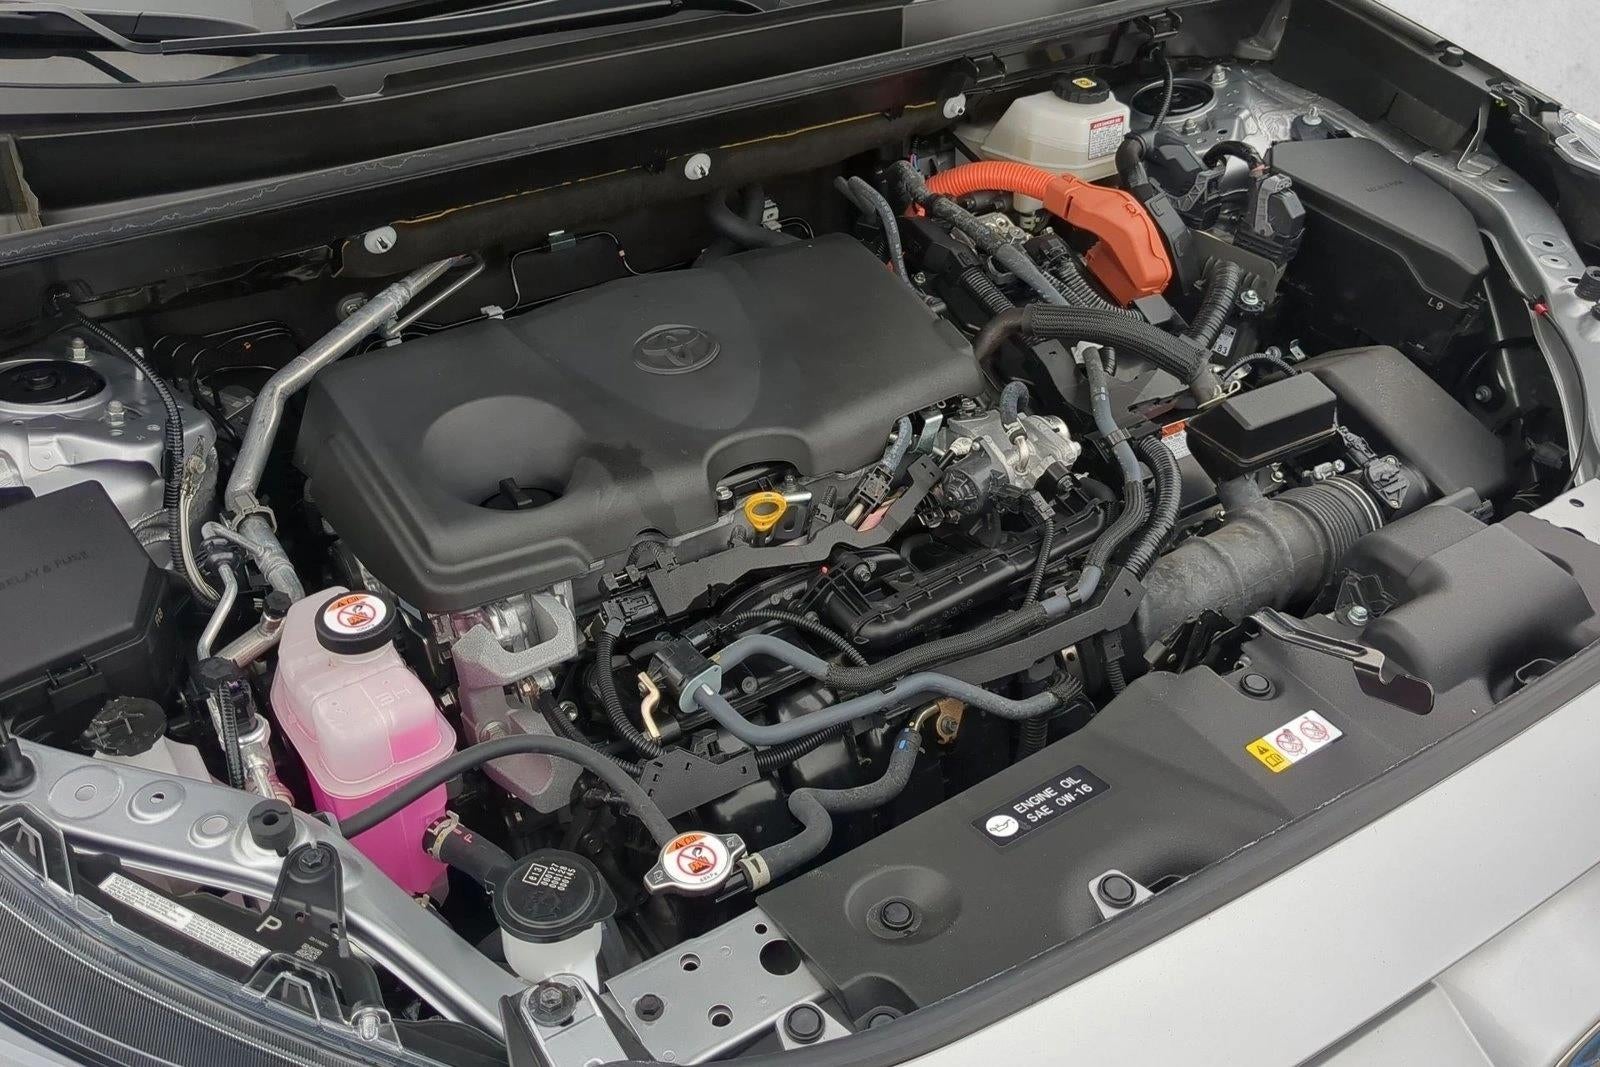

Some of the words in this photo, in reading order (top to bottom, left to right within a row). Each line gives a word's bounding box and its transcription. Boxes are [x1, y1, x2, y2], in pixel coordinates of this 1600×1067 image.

[1013, 786, 1059, 814] ENGINE
[1060, 776, 1082, 789] OIL
[1026, 804, 1054, 822] SAE
[1055, 783, 1093, 807] 0W-16
[255, 914, 283, 933] P
